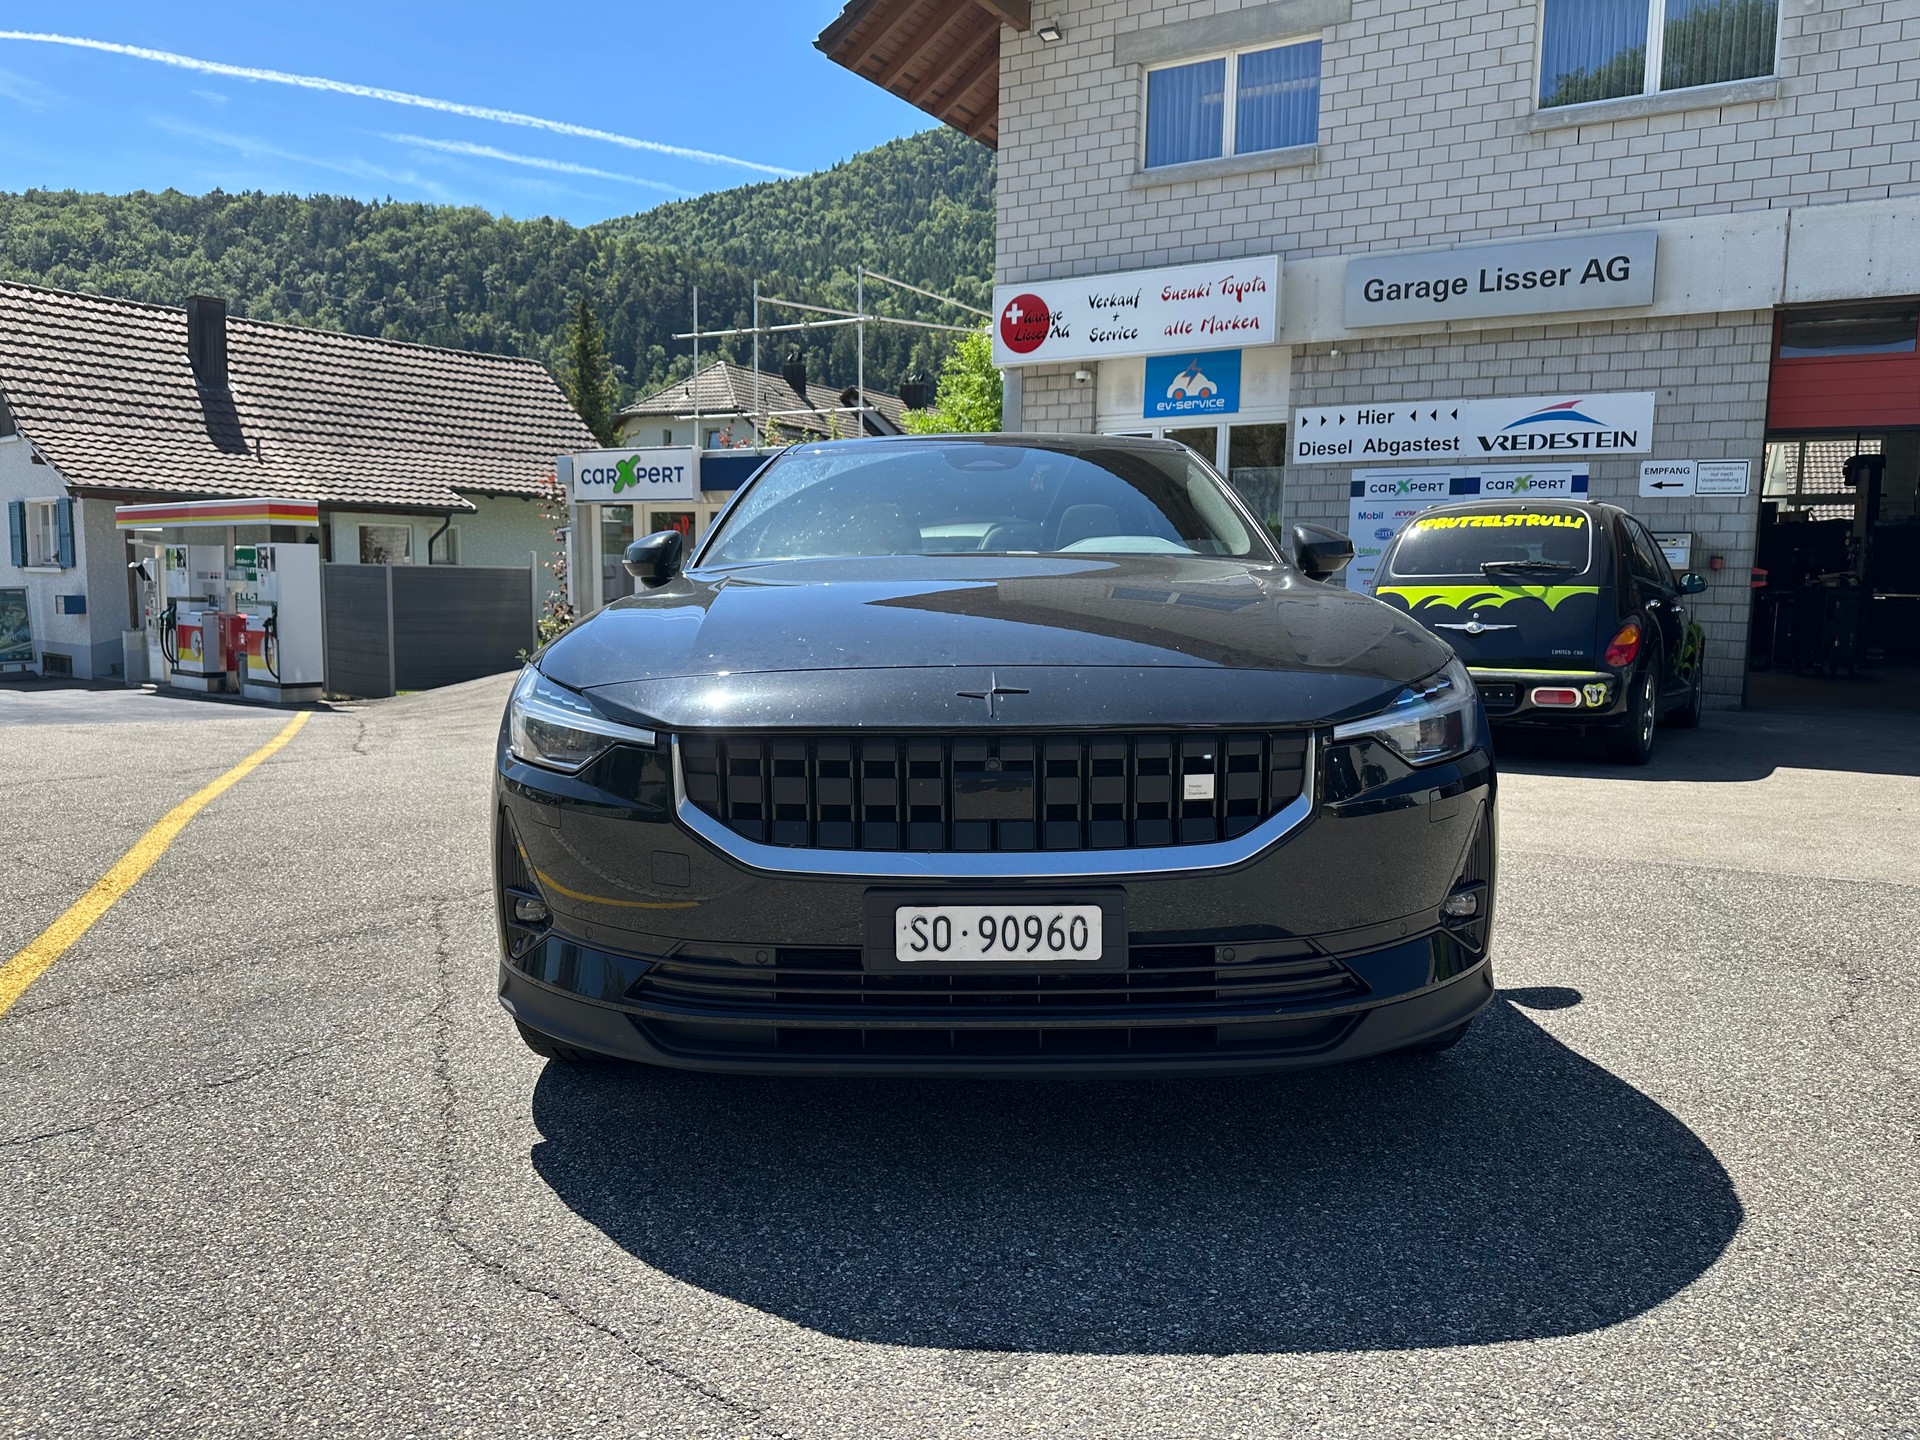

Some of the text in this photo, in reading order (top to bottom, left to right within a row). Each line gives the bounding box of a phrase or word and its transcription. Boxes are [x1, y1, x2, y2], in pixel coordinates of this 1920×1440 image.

[1363, 255, 1631, 303] Garage Lisser AG
[1088, 288, 1142, 309] Verkauf
[1161, 275, 1267, 304] Suzuki Toyota
[1023, 309, 1063, 326] Garage
[1164, 315, 1260, 337] alle Marken
[1014, 323, 1071, 342] Lisser AG
[1089, 325, 1139, 343] Service
[1156, 398, 1225, 411] ev-service
[1357, 409, 1396, 425] Hier
[1298, 435, 1460, 457] Diesel Abgastest
[1476, 430, 1638, 452] VREDESTEIN
[1644, 466, 1690, 475] EMPFANG
[1358, 511, 1384, 520] Mobil
[1358, 547, 1382, 555] Valeo
[910, 914, 1089, 953] SO 90960
